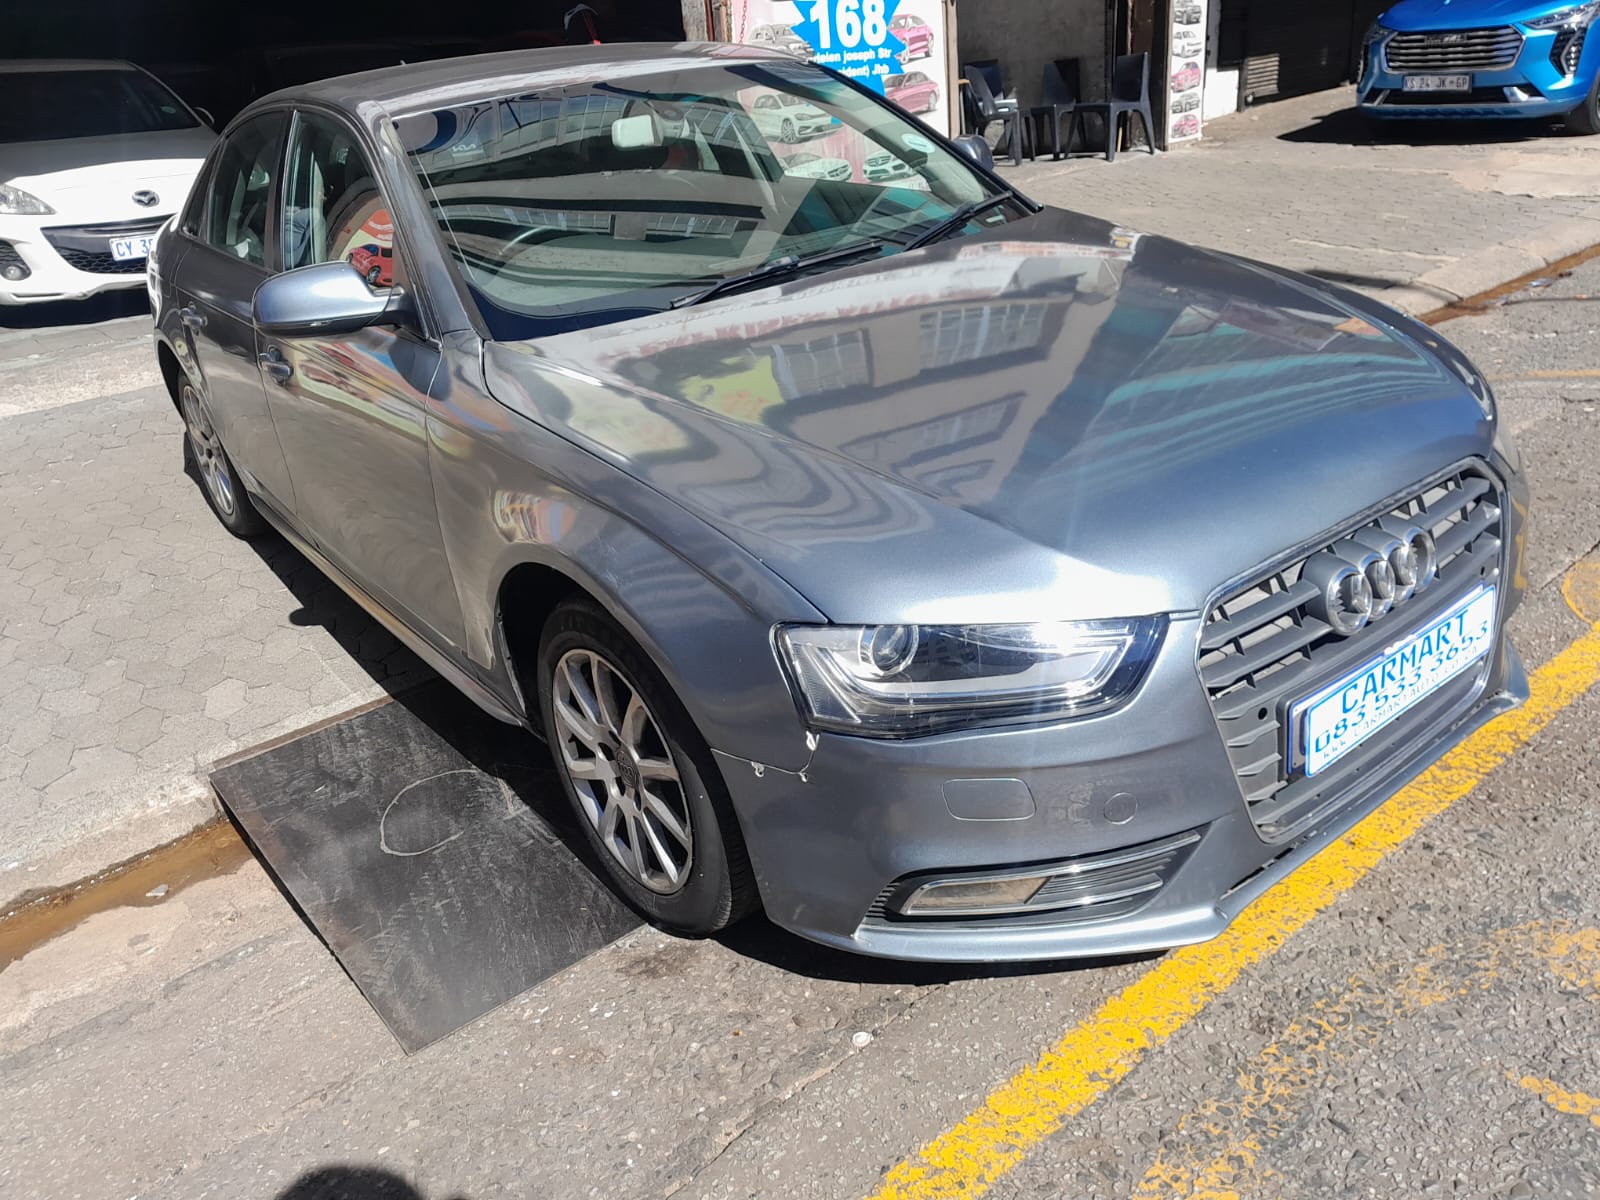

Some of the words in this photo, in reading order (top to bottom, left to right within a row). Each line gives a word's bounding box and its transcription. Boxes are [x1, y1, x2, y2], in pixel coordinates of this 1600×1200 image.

[810, 0, 887, 48] 168
[838, 64, 870, 78] ident)
[872, 64, 889, 75] Jhb
[843, 49, 875, 64] joseph
[878, 47, 892, 59] Str
[116, 241, 132, 257] CY
[1342, 609, 1468, 714] CARMART
[1315, 703, 1366, 753] 083
[1375, 665, 1422, 711] 533
[1430, 620, 1488, 673] 3653
